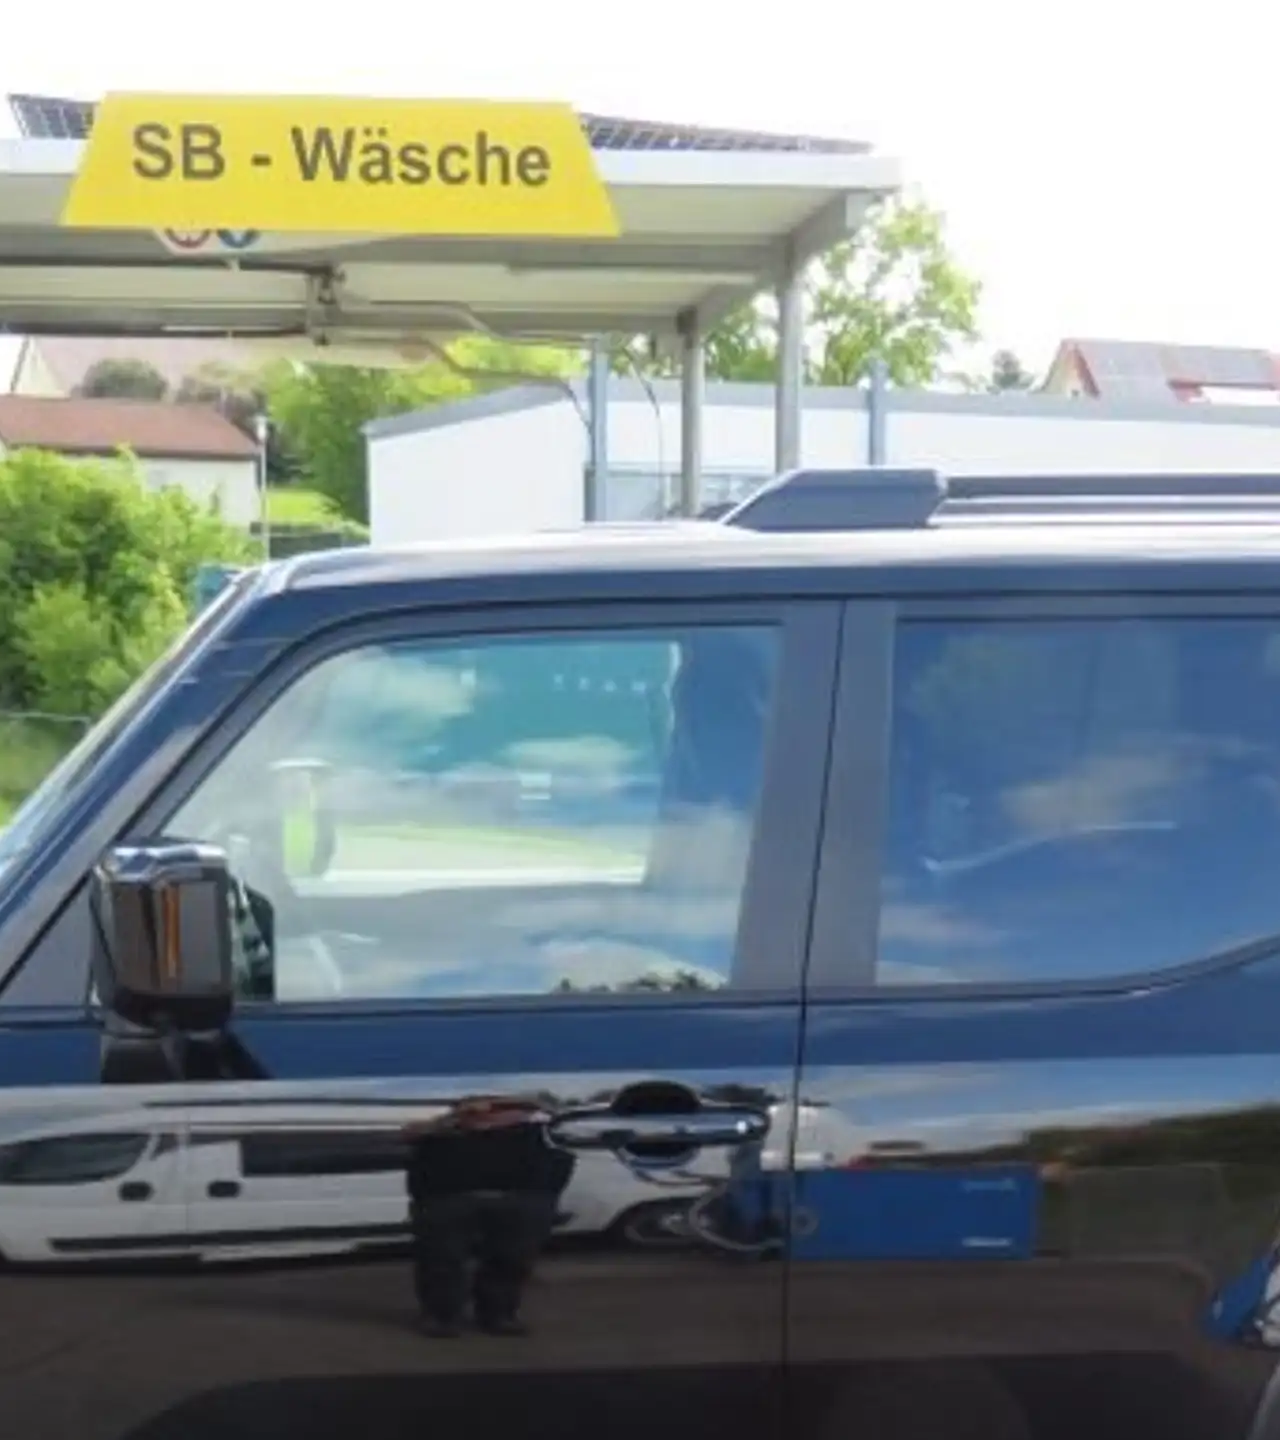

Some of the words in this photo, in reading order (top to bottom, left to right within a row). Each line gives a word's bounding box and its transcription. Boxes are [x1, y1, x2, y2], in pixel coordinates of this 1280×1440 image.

[133, 123, 225, 180] SB
[251, 155, 272, 167] -
[291, 127, 551, 186] Wäsche
